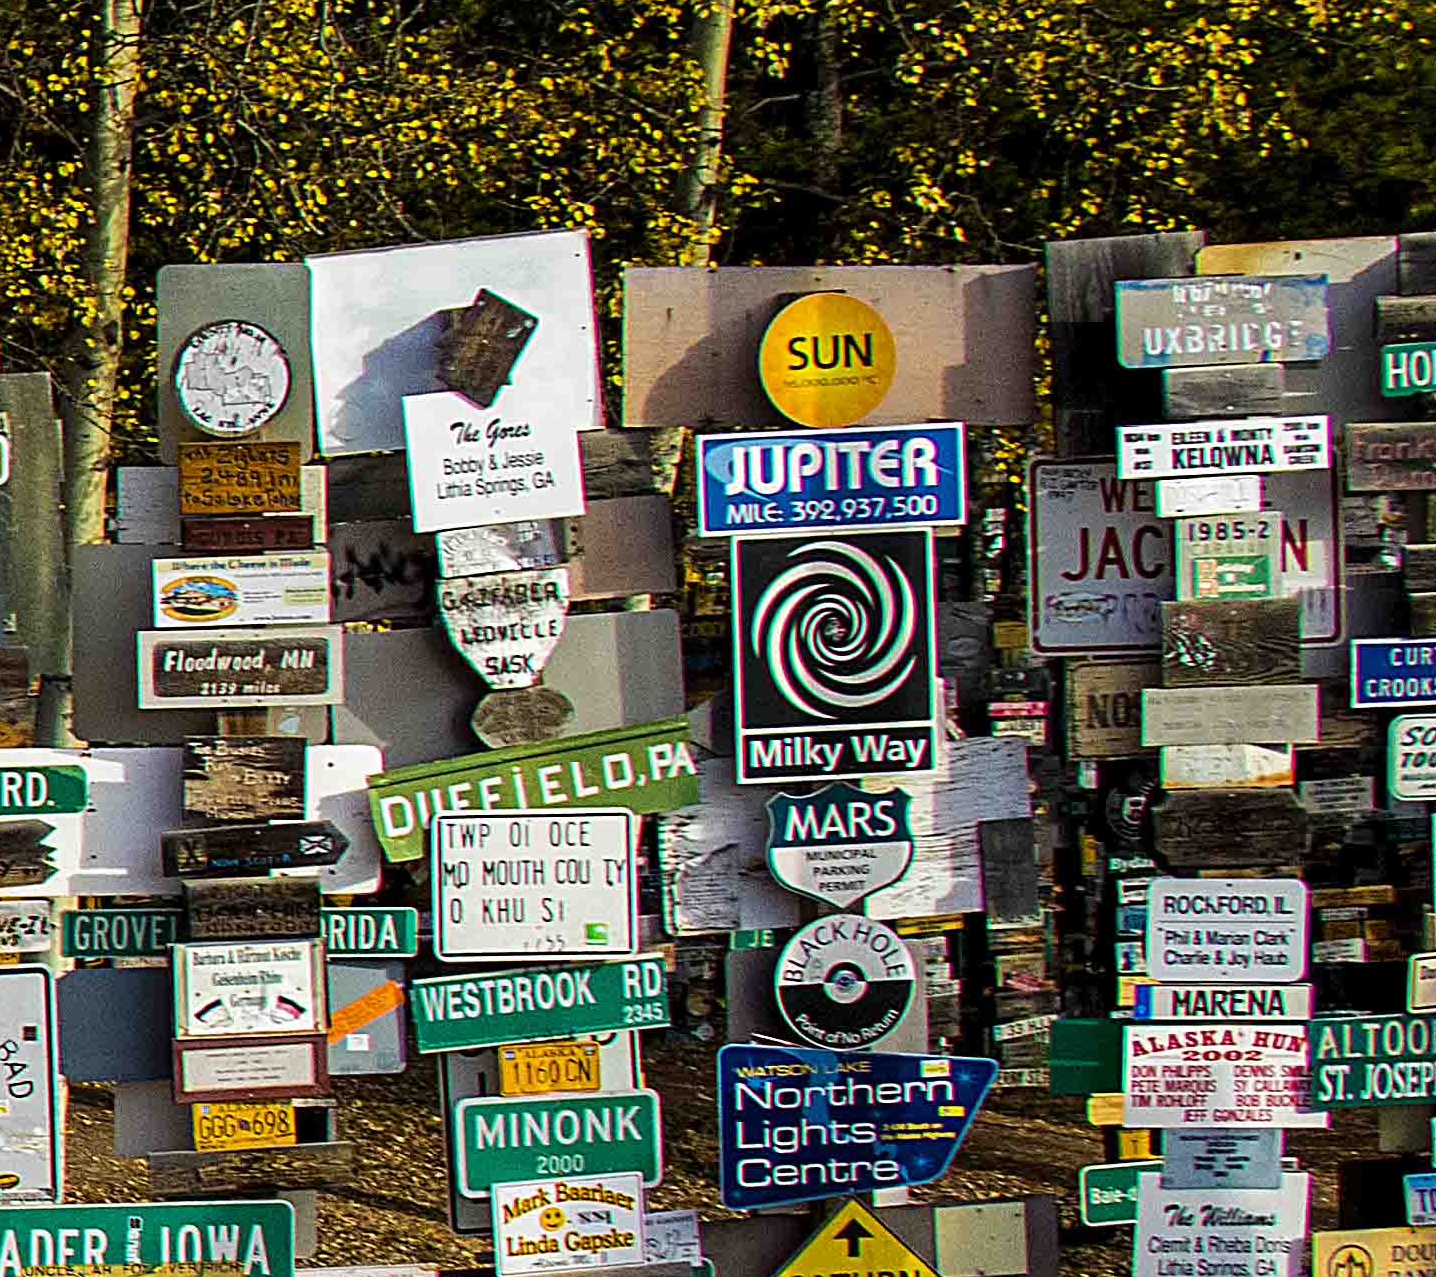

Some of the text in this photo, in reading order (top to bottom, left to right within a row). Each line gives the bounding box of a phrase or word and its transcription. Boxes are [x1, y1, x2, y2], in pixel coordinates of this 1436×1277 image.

[788, 333, 873, 371] SUN
[448, 420, 531, 446] The Gores
[726, 436, 939, 495] JUPITER
[1172, 444, 1276, 470] KELOWNA
[726, 495, 938, 525] MILE: 392,937,500
[749, 735, 927, 768] Milky Way
[784, 800, 897, 841] MARS
[806, 848, 877, 862] MUNICIPAL
[812, 863, 871, 877] PARKING
[819, 880, 867, 892] PERMIT
[421, 964, 663, 1022] WESTBROOK RD
[1172, 990, 1285, 1016] MARENA
[624, 1003, 663, 1022] 2345
[1183, 1050, 1262, 1061] 2002
[737, 1061, 871, 1079] WATSON LAKE
[736, 1081, 954, 1110] Northern
[475, 1105, 643, 1151] MINONK
[737, 1121, 877, 1154] Lights
[537, 1156, 584, 1173] 2000
[737, 1158, 899, 1187] Centre
[506, 1229, 635, 1256] Linda Gapske
